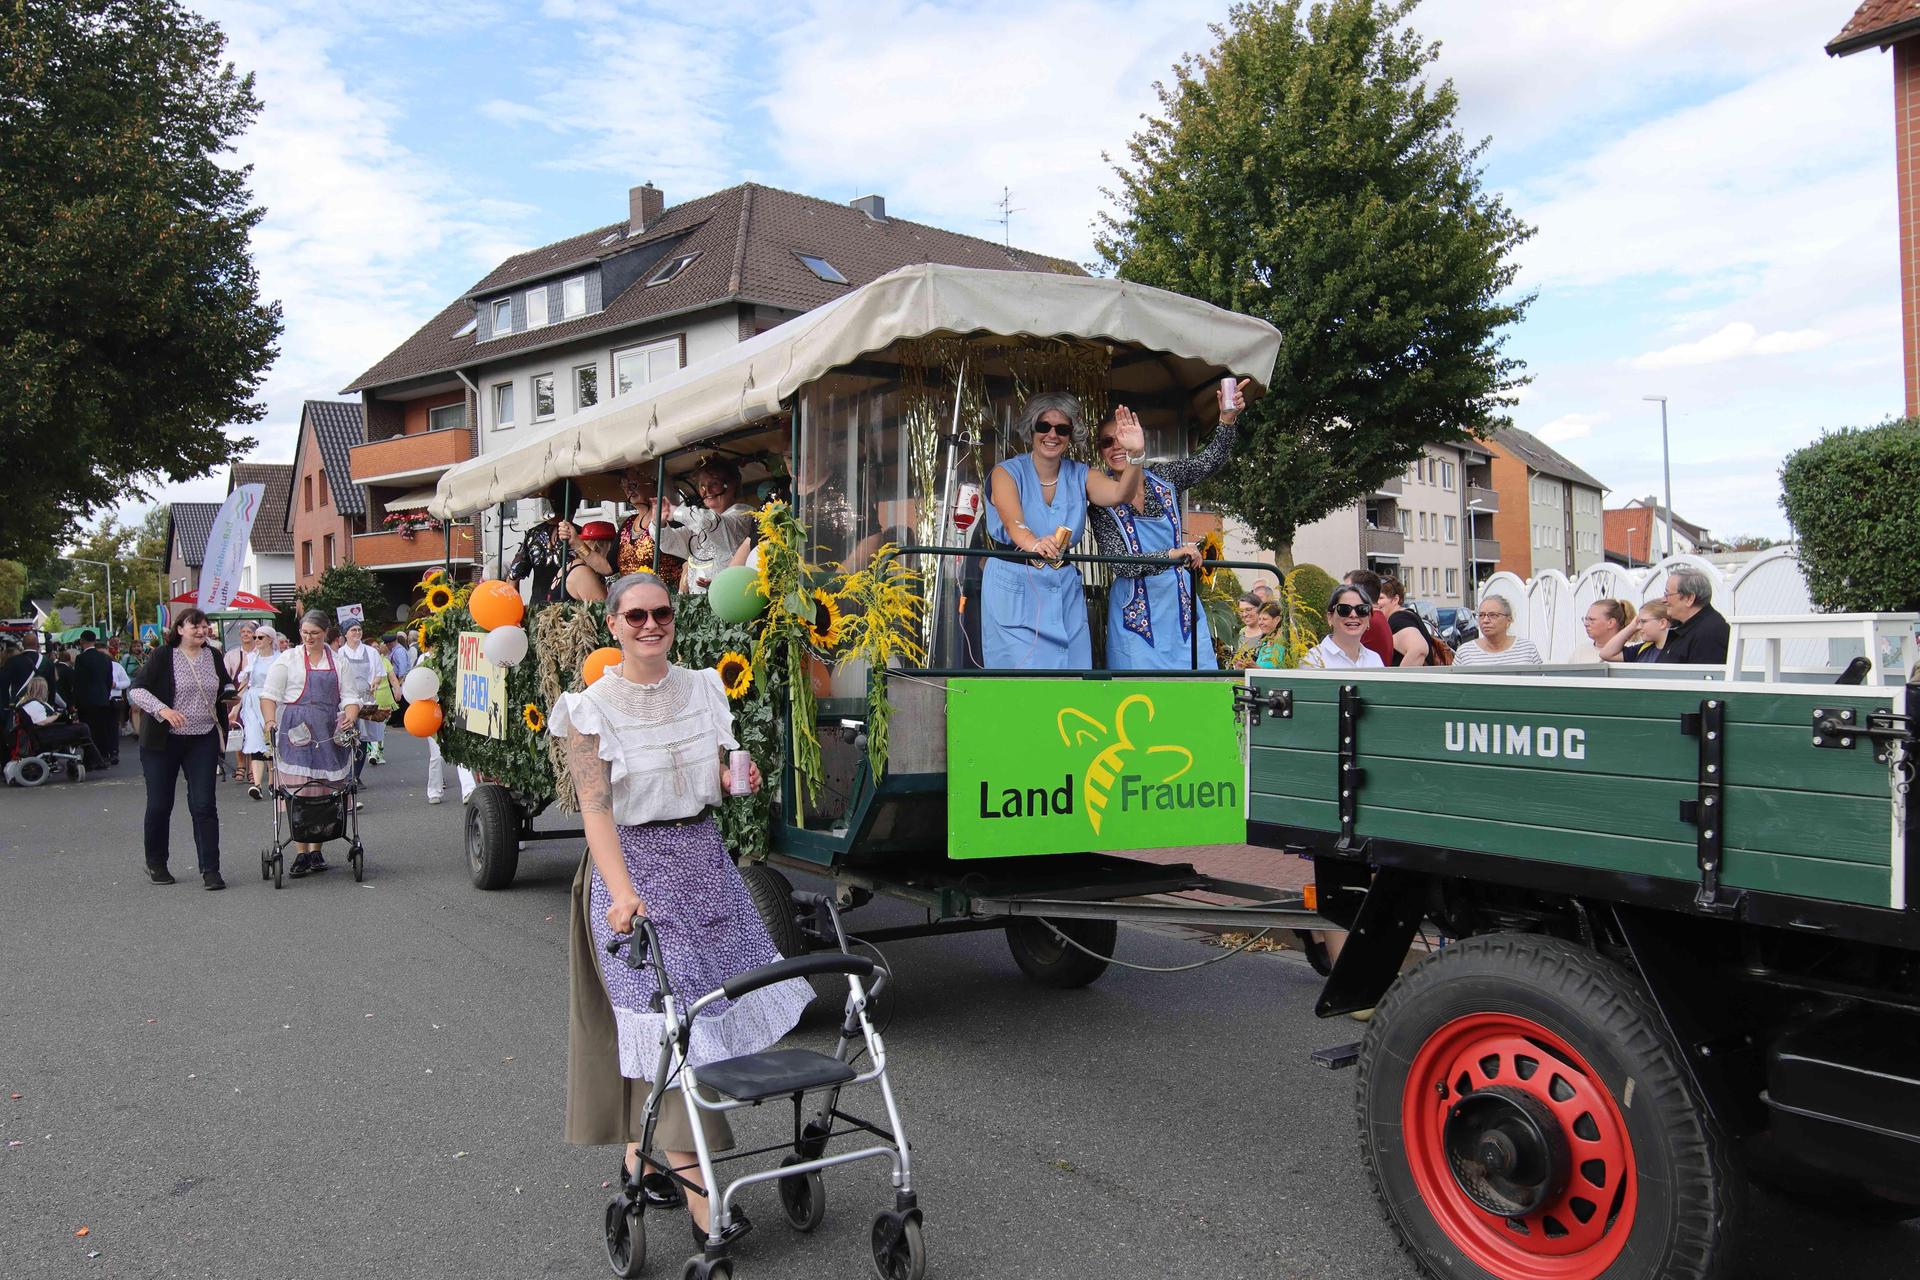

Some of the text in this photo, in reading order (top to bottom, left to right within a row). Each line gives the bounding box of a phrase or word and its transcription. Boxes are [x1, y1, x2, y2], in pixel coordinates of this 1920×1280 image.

[220, 580, 230, 606] Luthe
[1445, 721, 1586, 760] UNIMOG
[980, 774, 1236, 819] Land Frauen
